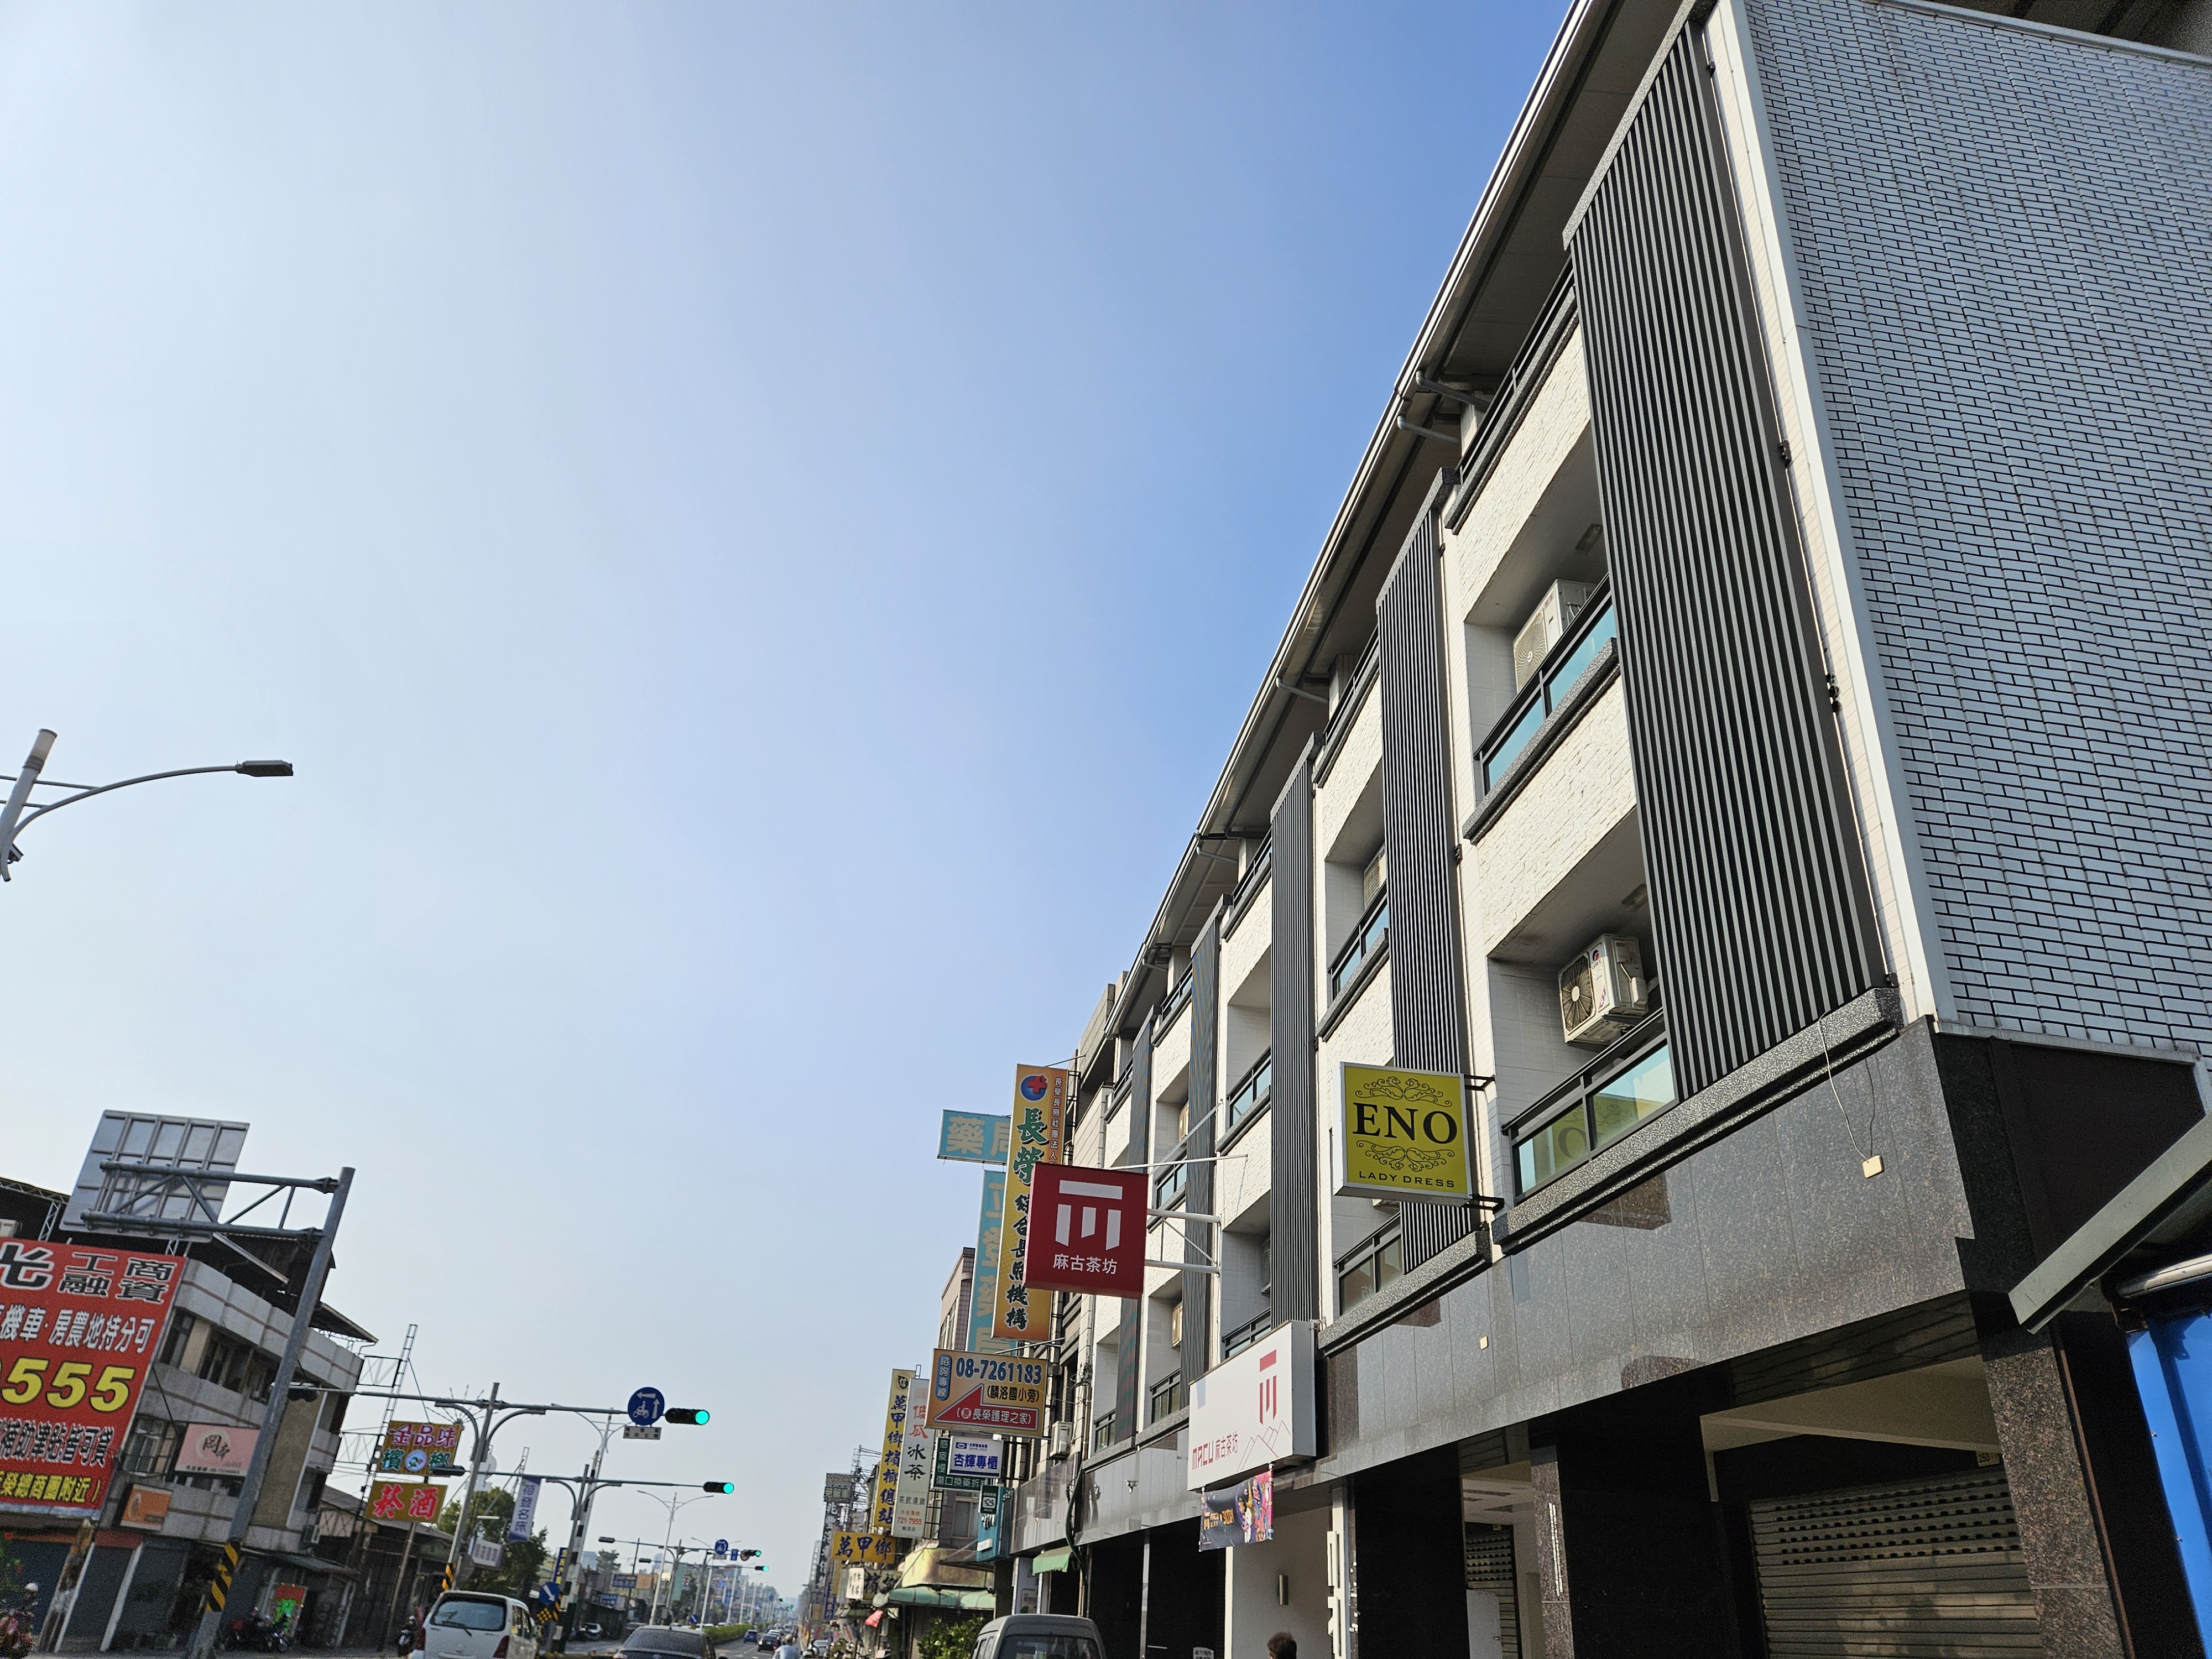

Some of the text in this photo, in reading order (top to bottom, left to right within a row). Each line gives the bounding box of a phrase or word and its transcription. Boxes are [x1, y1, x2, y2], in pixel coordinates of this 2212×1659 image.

[1049, 1077, 1063, 1164] 長榮長照社團法人
[1352, 1102, 1457, 1144] ENO
[1359, 1171, 1454, 1188] LADY DRESS
[65, 1251, 178, 1282] 工商
[1053, 1253, 1118, 1275] 麻古茶坊
[57, 1272, 169, 1305] 融資
[0, 1356, 136, 1413] 555
[956, 1357, 1042, 1385] 08-7261183
[388, 1423, 457, 1449] 金品味
[904, 1405, 929, 1481] 傻瓜冰茶
[1215, 1431, 1238, 1460] 麻古茶坊
[954, 1453, 998, 1469] 杏輝專櫃
[836, 1536, 892, 1560] 萬甲鄉
